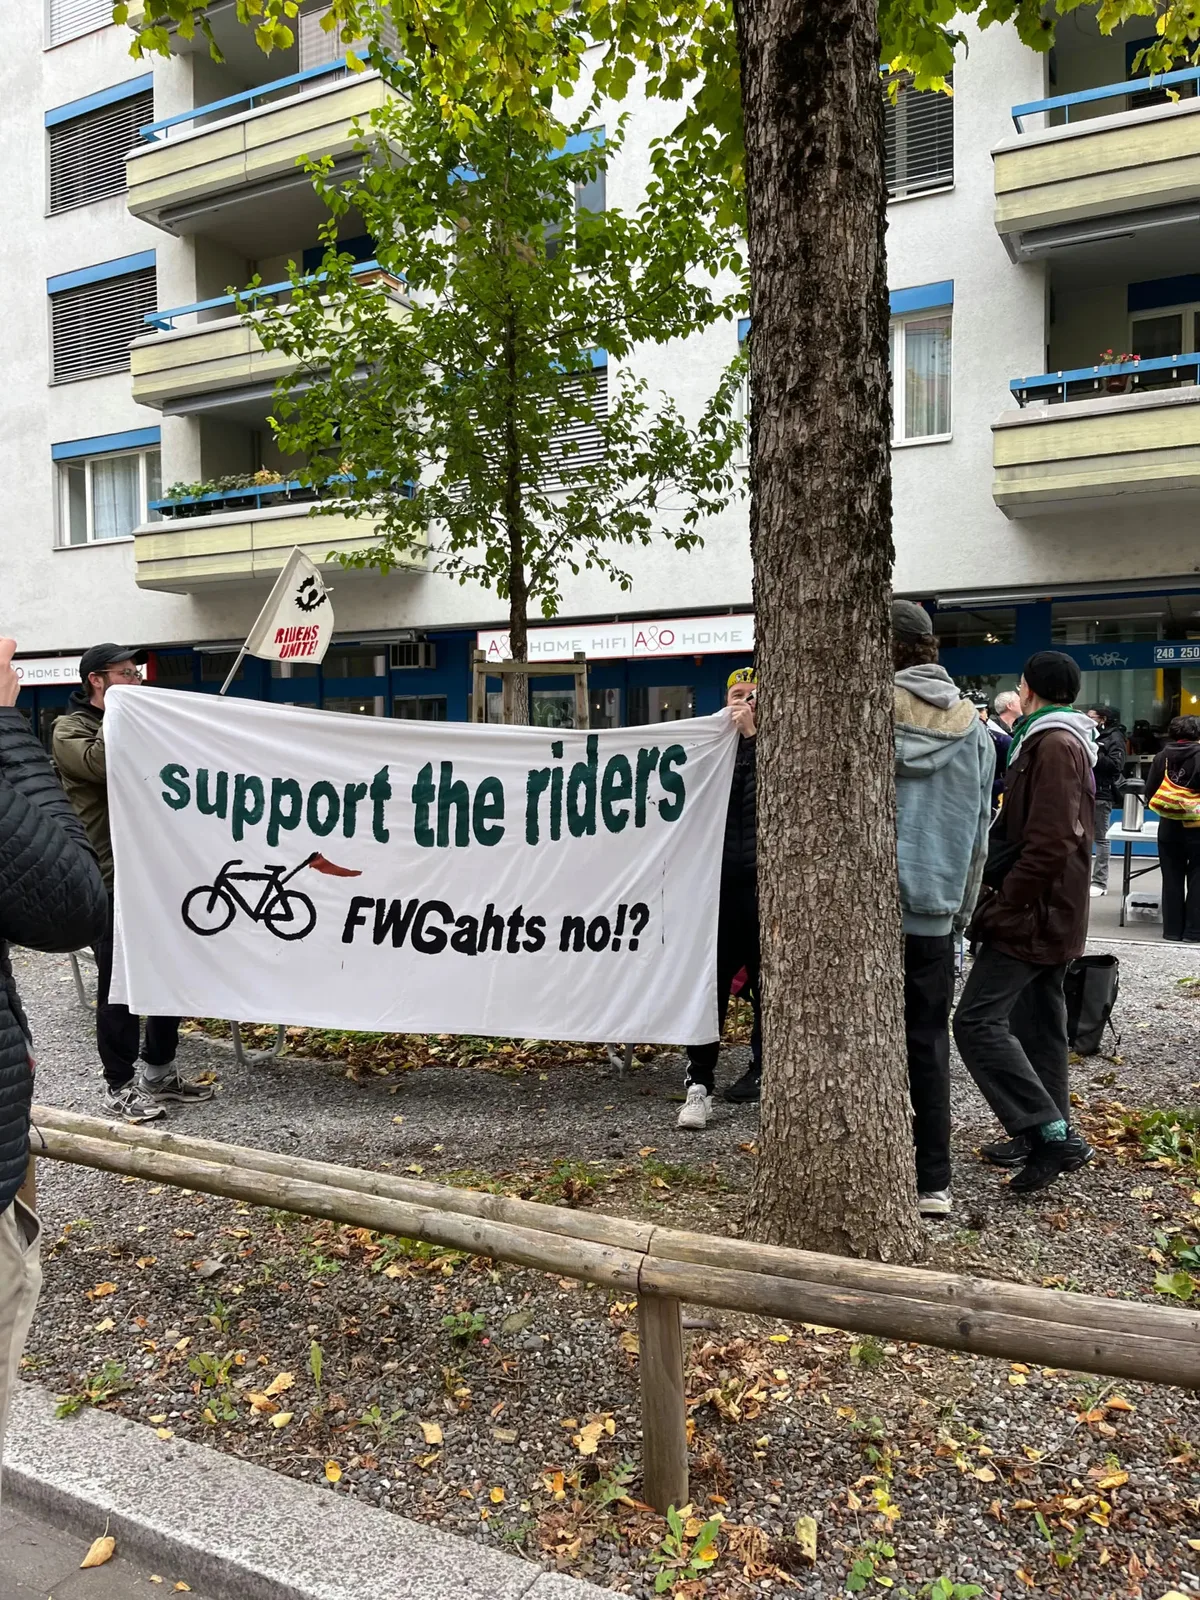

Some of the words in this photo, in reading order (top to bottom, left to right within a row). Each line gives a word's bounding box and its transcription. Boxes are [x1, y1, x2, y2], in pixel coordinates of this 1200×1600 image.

[530, 639, 582, 653] HOME
[592, 637, 626, 650] HIFI
[634, 625, 675, 652] A&O
[682, 630, 743, 645] HOME
[279, 640, 319, 659] UNITE!
[1180, 646, 1200, 658] 250
[27, 668, 60, 679] HOME
[159, 762, 392, 847] support
[411, 761, 505, 847] the
[525, 734, 687, 846] riders
[341, 896, 546, 956] FWGahts
[559, 902, 650, 952] no!?
